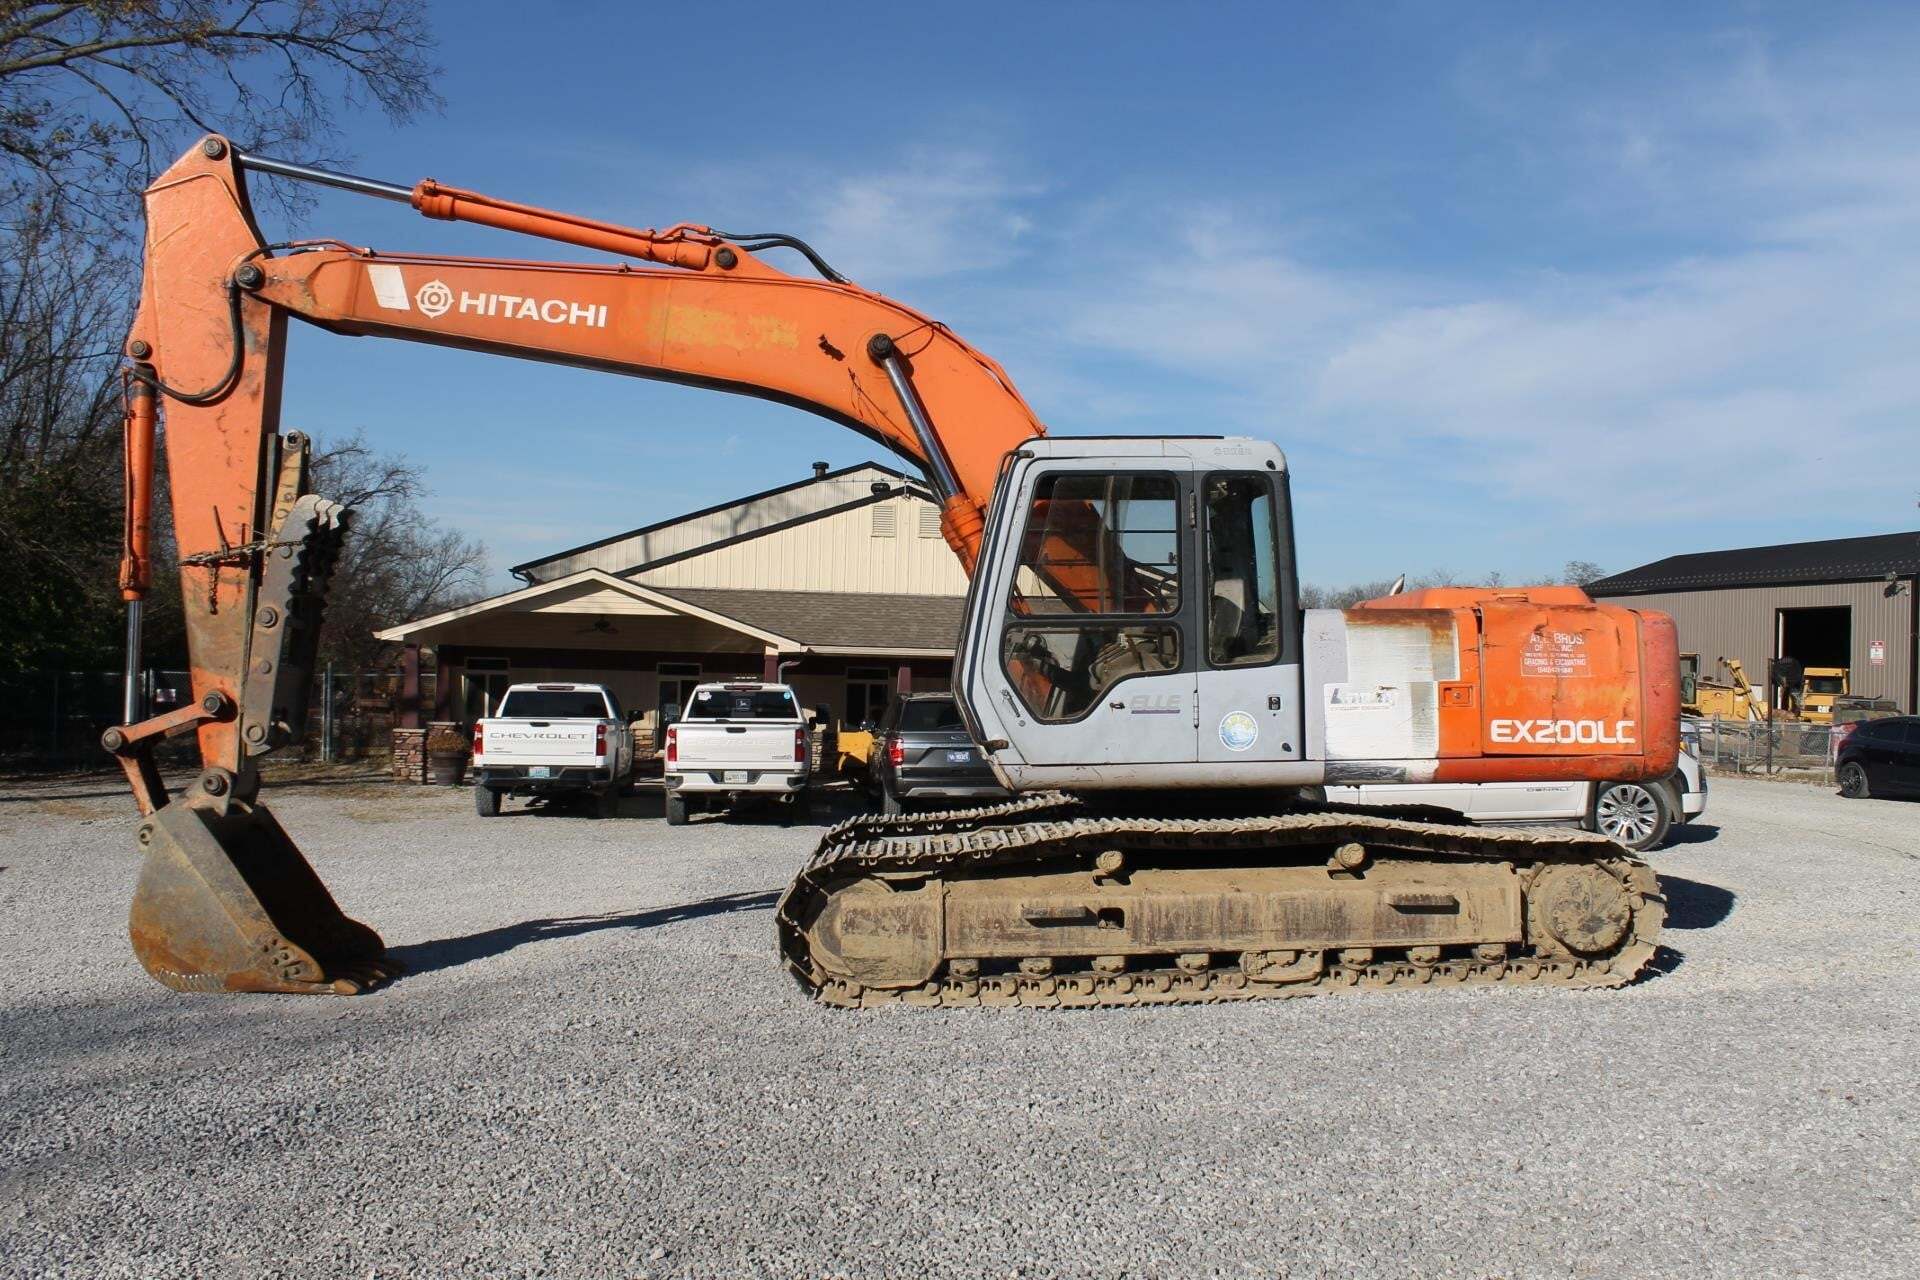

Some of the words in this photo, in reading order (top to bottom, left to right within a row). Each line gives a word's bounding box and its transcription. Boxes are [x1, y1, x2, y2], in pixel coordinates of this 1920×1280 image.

[459, 291, 608, 328] HITACHI
[489, 731, 588, 740] CHEVROLET
[1490, 719, 1636, 744] EX200LC
